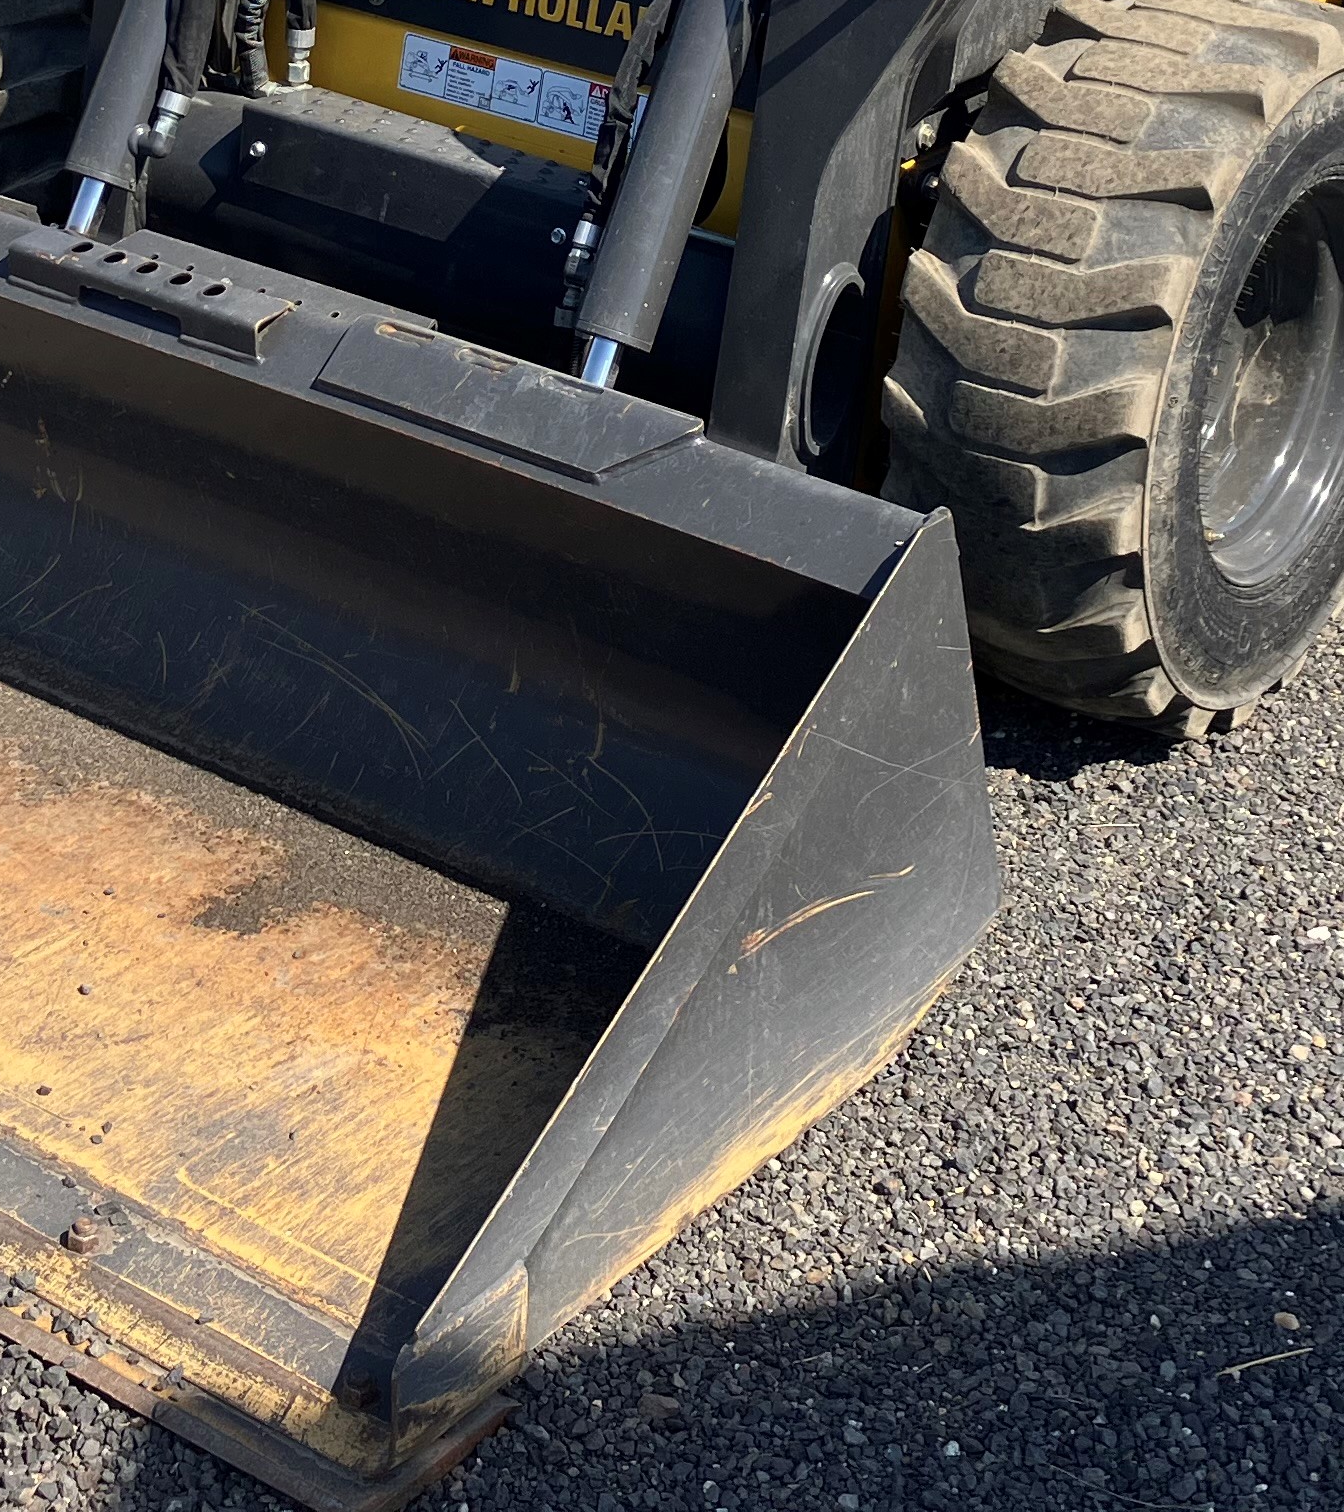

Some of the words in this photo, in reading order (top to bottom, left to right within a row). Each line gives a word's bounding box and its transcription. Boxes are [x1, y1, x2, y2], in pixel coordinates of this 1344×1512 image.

[458, 50, 495, 68] WARNING
[452, 62, 466, 71] FALL
[467, 66, 490, 77] HAZARD
